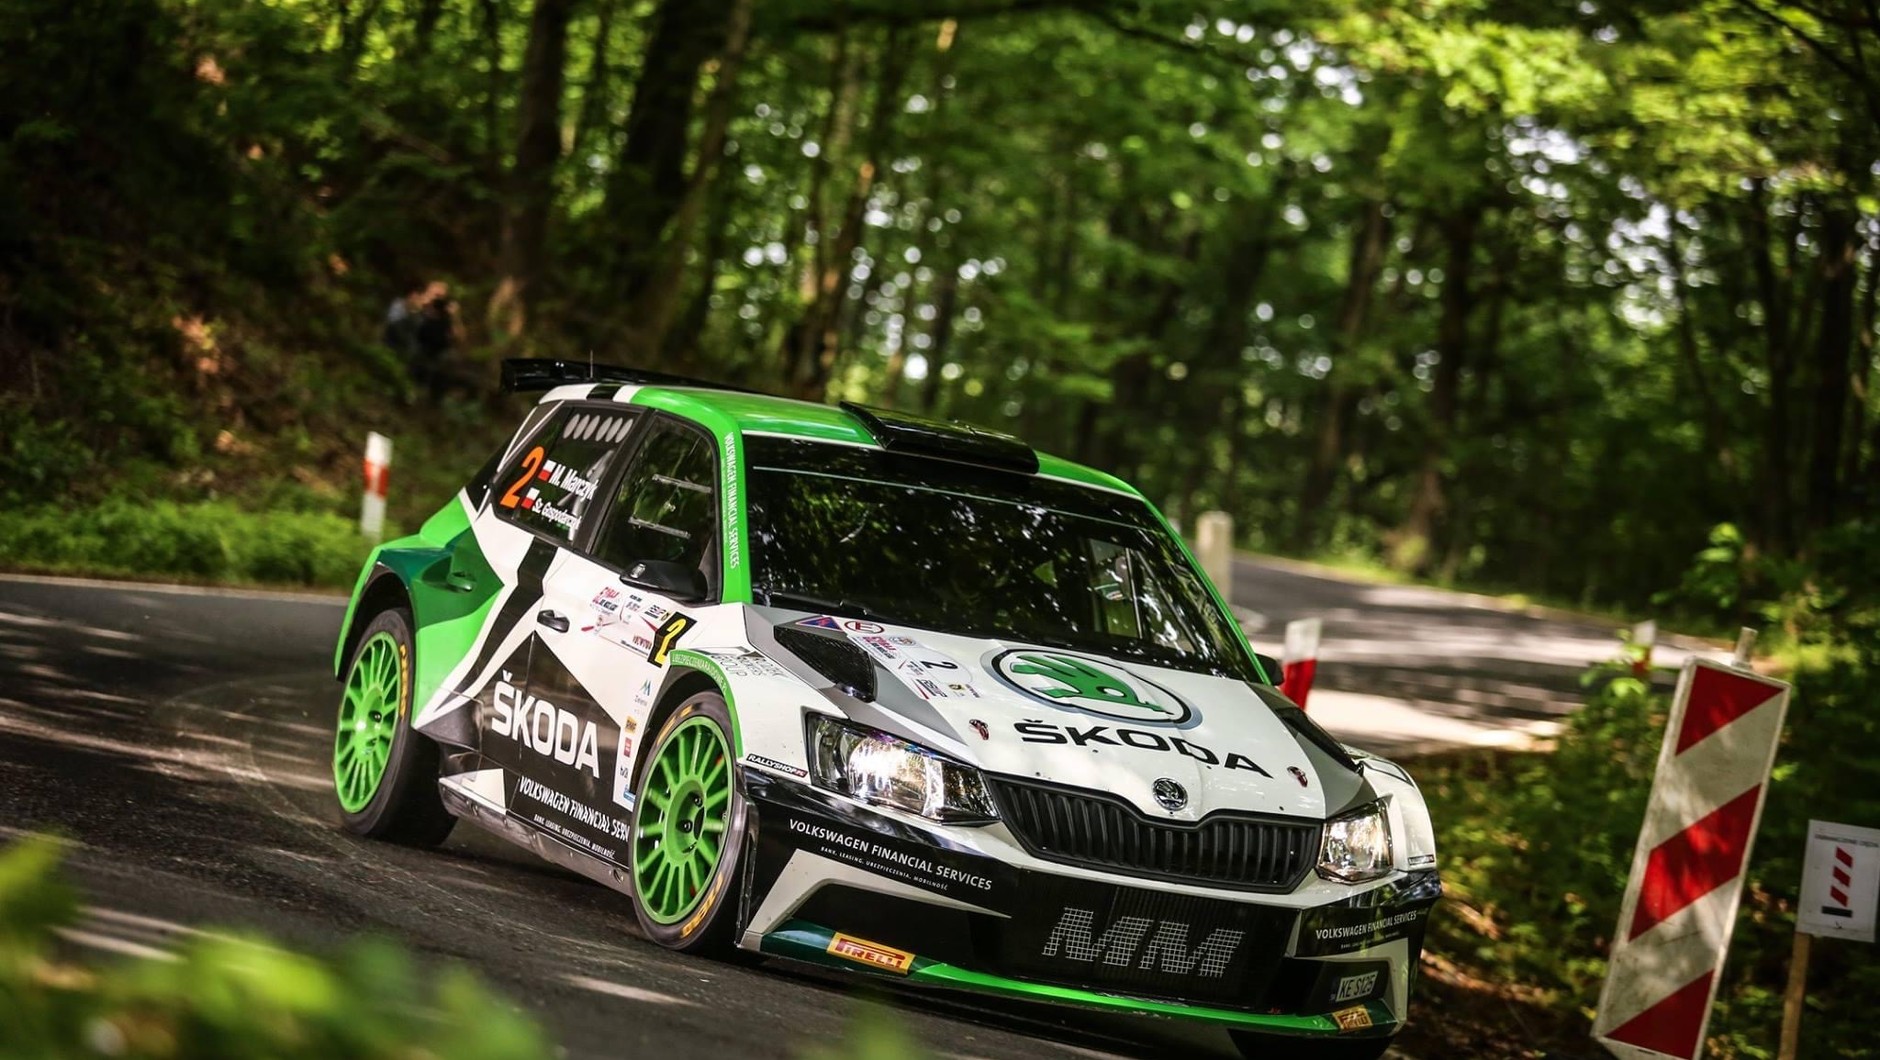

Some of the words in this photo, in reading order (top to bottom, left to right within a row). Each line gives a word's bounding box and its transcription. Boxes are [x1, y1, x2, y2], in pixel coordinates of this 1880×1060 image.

[500, 446, 545, 509] 2
[548, 463, 566, 487] M.
[560, 468, 599, 502] Marczyk
[727, 482, 738, 528] FINANCIAL
[729, 527, 740, 569] SERVICES
[655, 618, 687, 665] 2
[919, 660, 959, 671] 2
[491, 669, 600, 779] ŠKODA
[1013, 718, 1274, 780] ŠKODA
[519, 775, 571, 814] VOLKSWAGEN
[569, 799, 610, 834] FINANCIAL
[788, 818, 869, 853] VOLKSWAGEN
[871, 844, 933, 873] FINANCIAL
[935, 865, 992, 891] SERVICES
[1041, 906, 1246, 978] MM
[1315, 923, 1368, 940] VOLKSWAGEN
[1367, 916, 1394, 934] FINANCIAL
[1393, 910, 1417, 926] SERVICES
[835, 937, 906, 969] PIRELLI
[1338, 979, 1354, 999] KE
